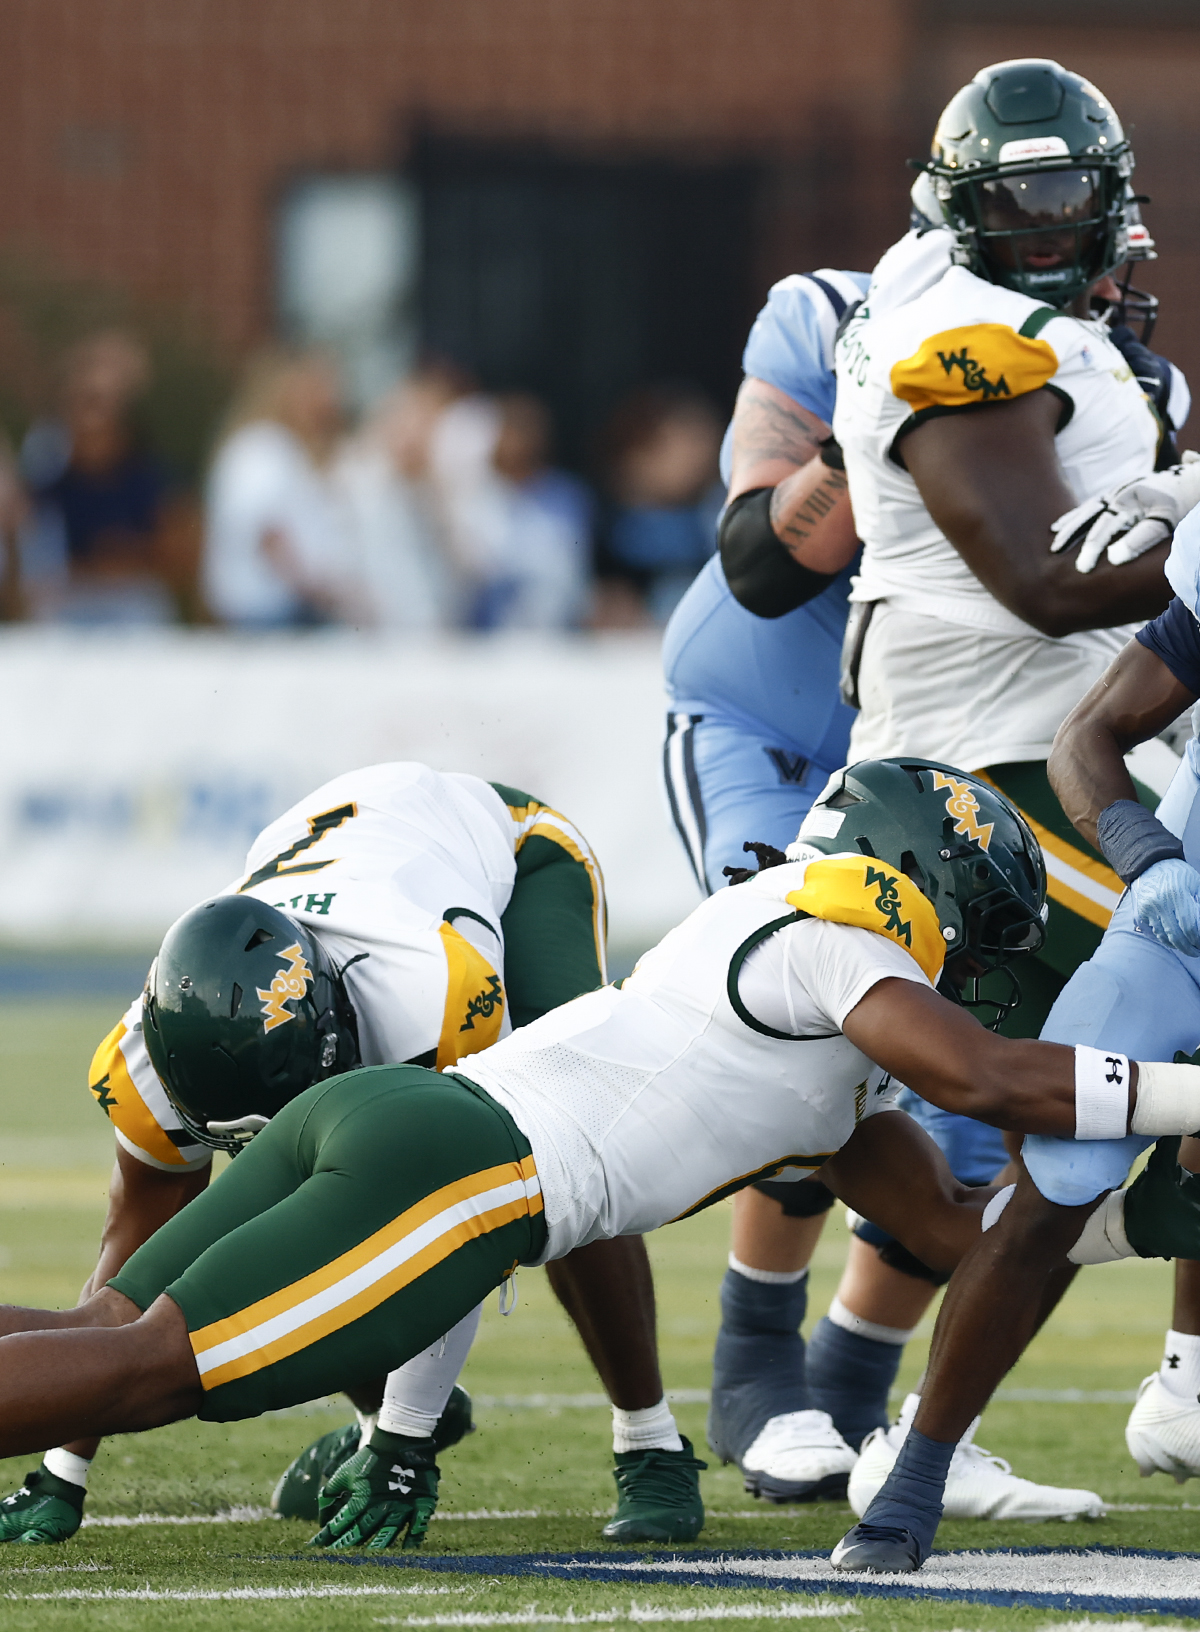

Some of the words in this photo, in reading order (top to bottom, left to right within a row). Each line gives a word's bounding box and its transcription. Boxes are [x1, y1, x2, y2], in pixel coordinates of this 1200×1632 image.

[929, 769, 995, 855] W&M
[863, 864, 913, 950] W&M
[255, 939, 316, 1036] W&M
[458, 974, 503, 1033] W&M
